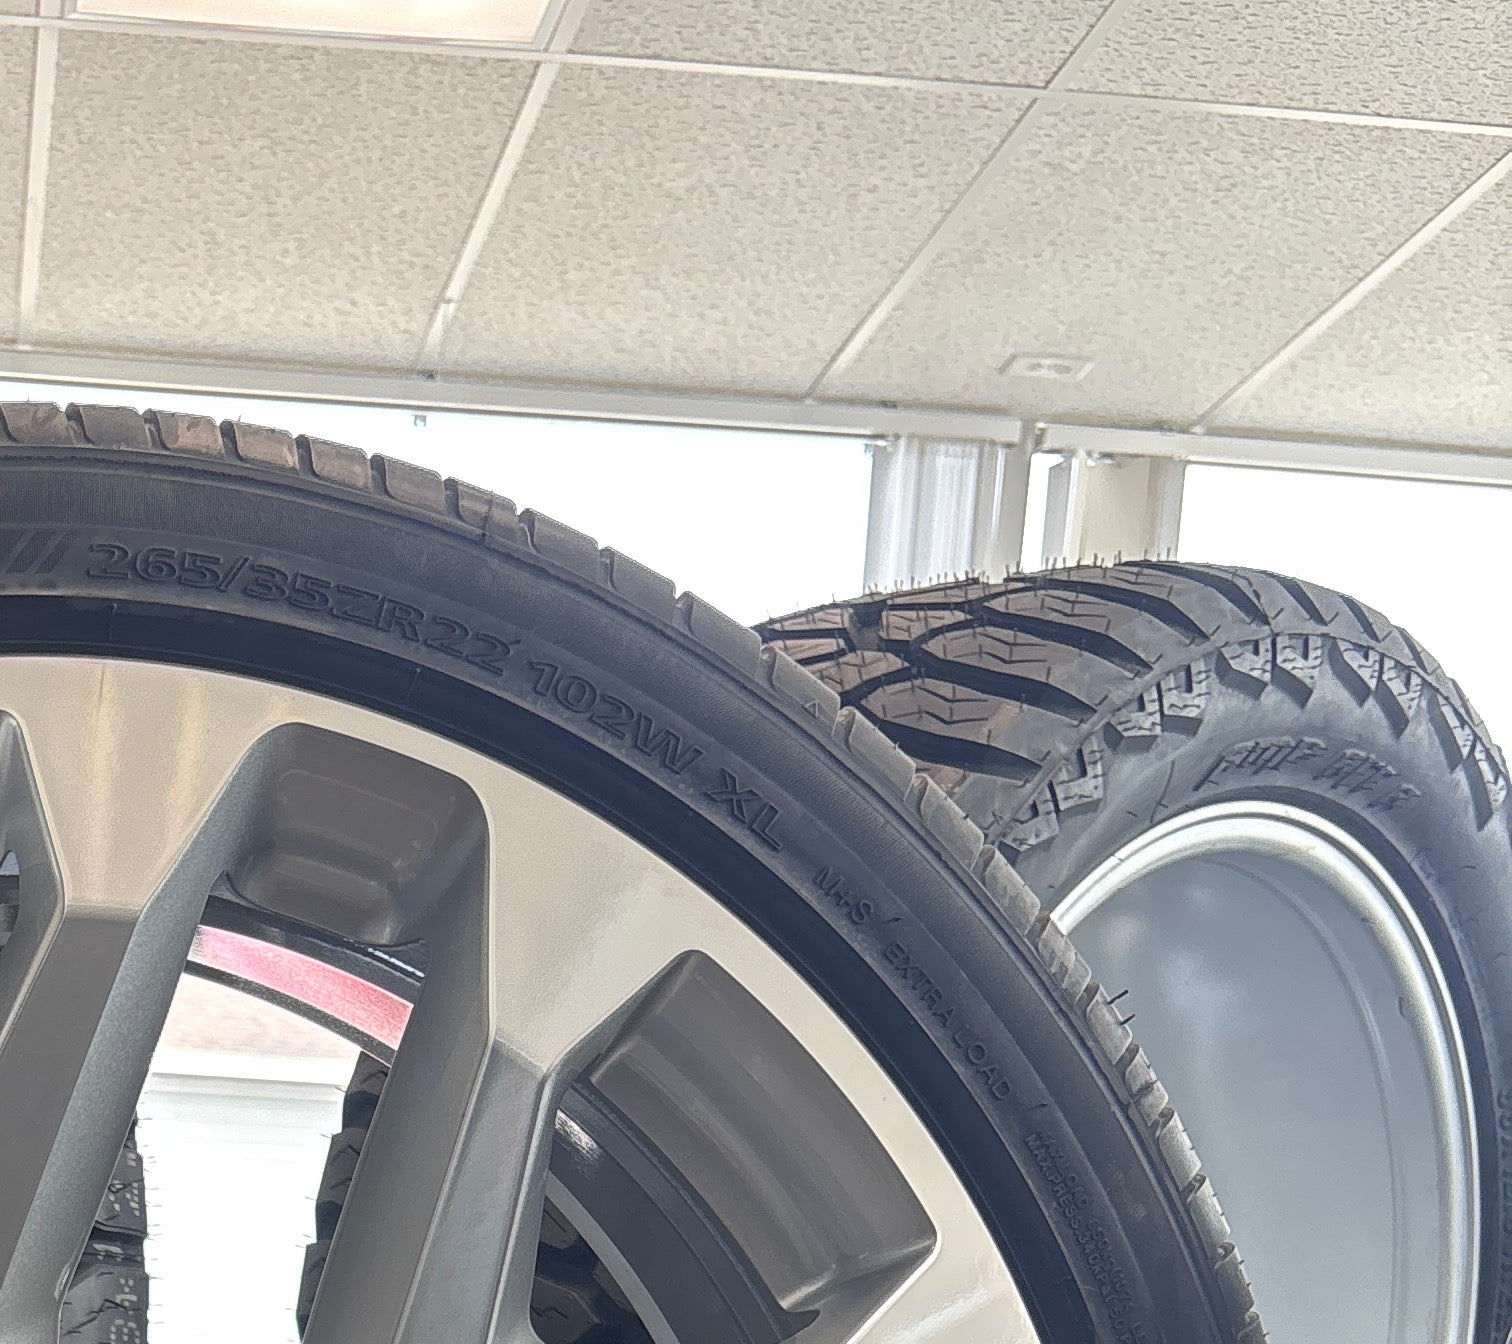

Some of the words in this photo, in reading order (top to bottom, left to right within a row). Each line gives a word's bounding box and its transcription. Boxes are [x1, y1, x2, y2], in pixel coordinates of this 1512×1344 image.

[86, 541, 514, 680] 265/35ZR22
[529, 655, 701, 781] 102W
[702, 768, 785, 853] XL
[813, 864, 876, 928] M+S
[879, 937, 958, 1028] EXTRA
[951, 1026, 1012, 1105] LOAD
